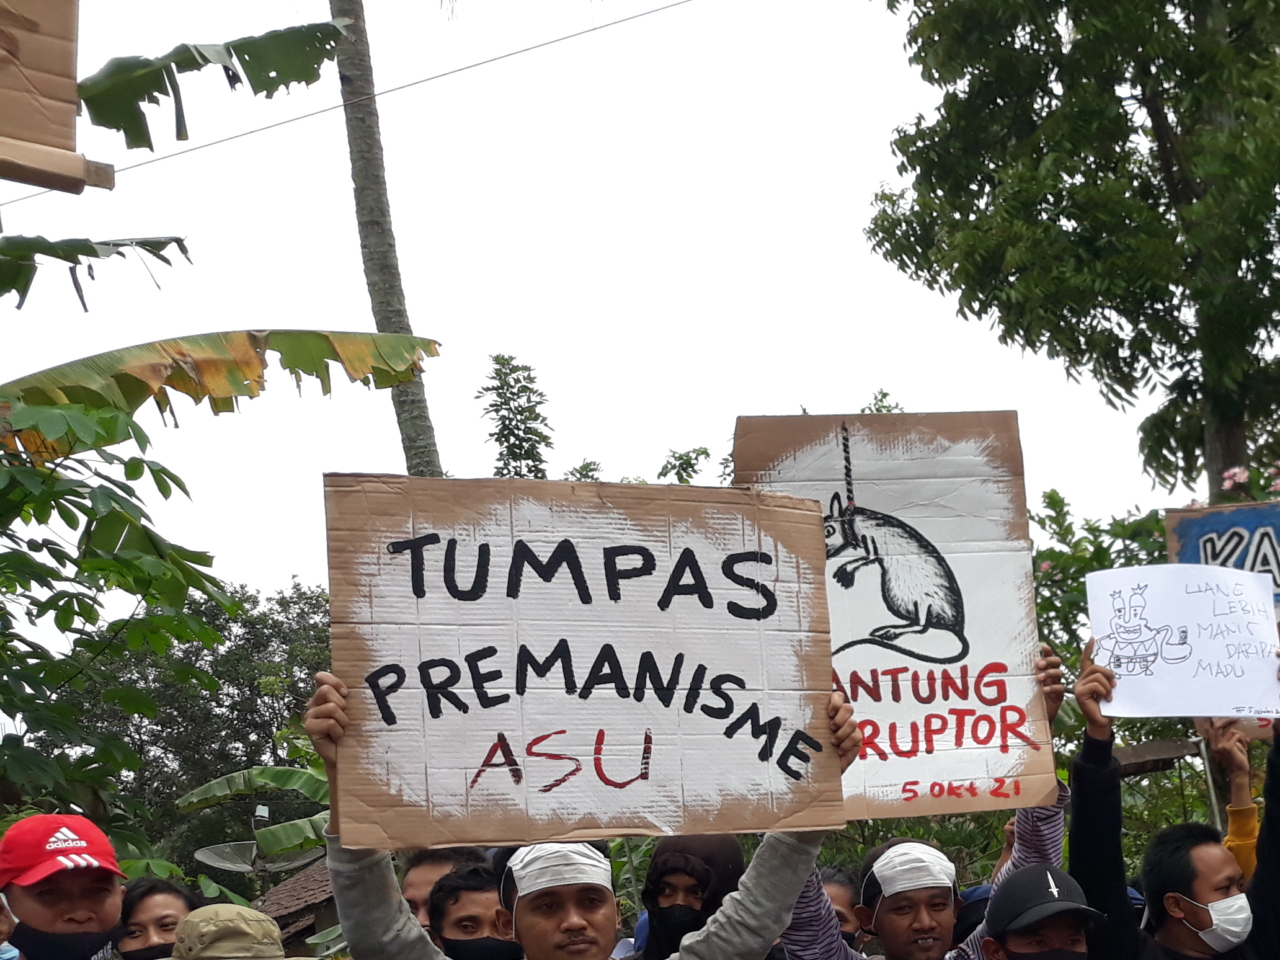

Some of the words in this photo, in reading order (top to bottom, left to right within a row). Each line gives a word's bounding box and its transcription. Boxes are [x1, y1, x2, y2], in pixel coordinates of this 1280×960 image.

[387, 533, 778, 621] TUMPAS
[1213, 599, 1268, 620] LEBIH
[1193, 659, 1245, 678] MADU
[365, 638, 823, 781] PREMANISME
[469, 727, 653, 793] ASU
[902, 780, 919, 802] 5
[989, 777, 1021, 798] 21
[45, 839, 87, 850] adidas
